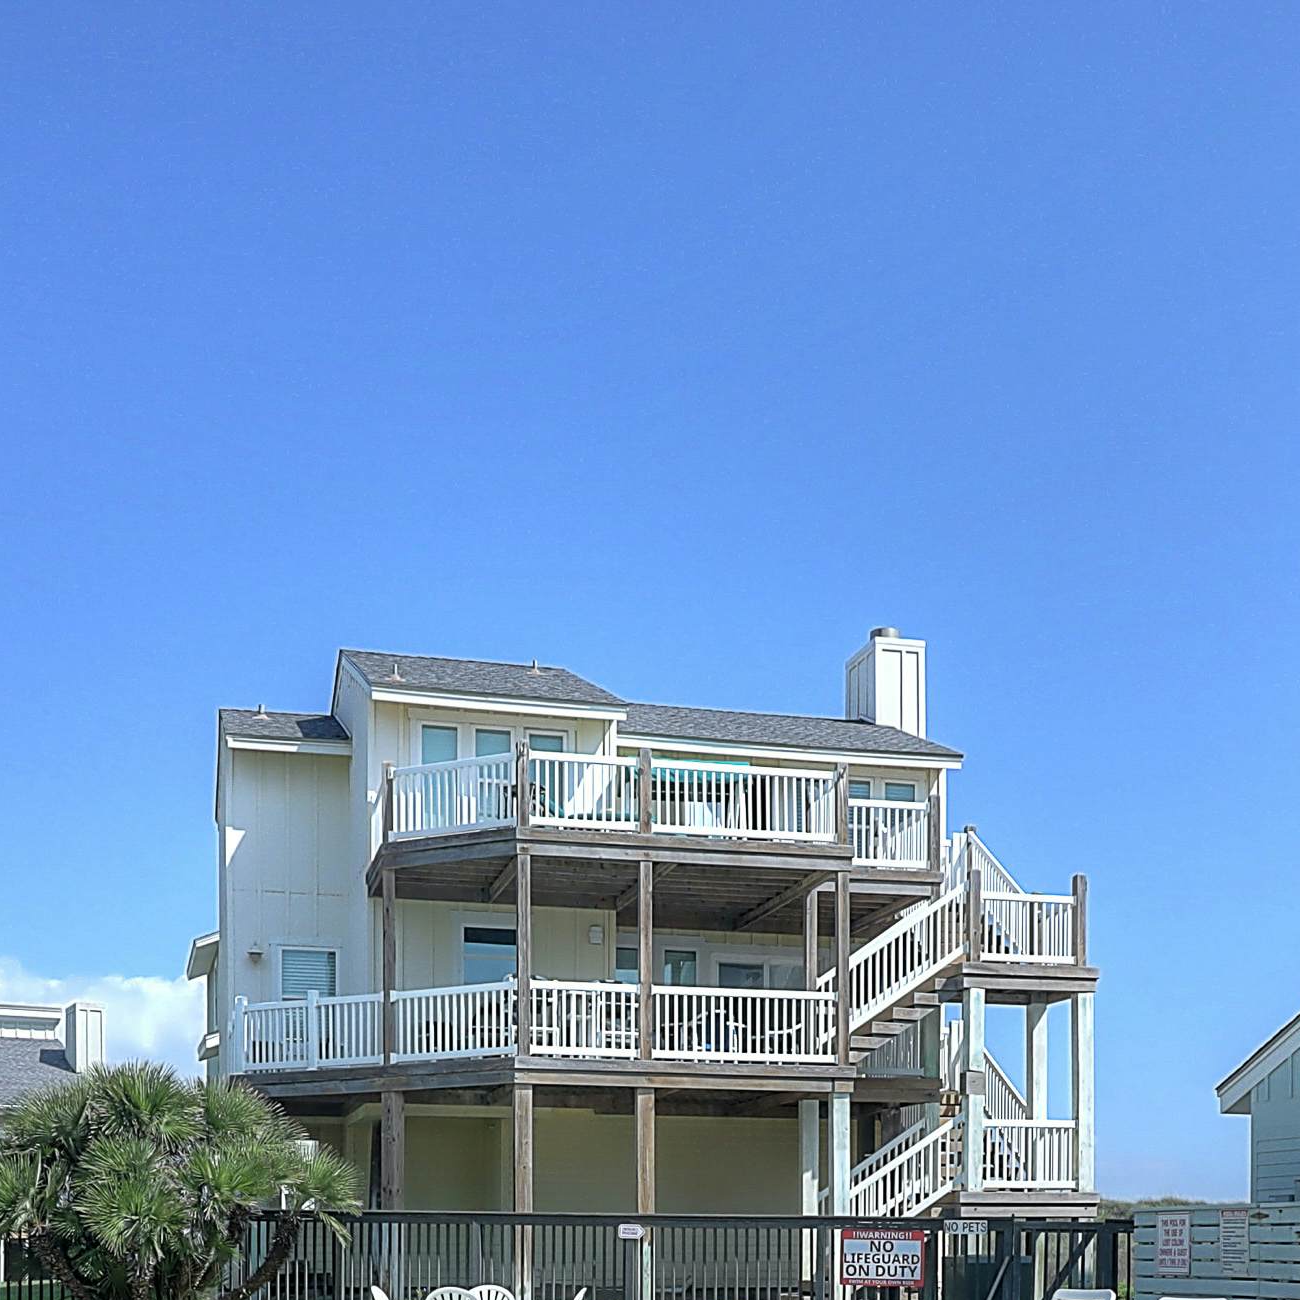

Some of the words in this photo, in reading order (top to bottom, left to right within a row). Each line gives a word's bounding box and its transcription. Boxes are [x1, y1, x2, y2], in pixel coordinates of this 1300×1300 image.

[945, 1222, 959, 1232] NO
[962, 1222, 987, 1233] PETS
[870, 1241, 894, 1253] NO
[844, 1253, 920, 1265] LIFEGUARD
[846, 1264, 870, 1276] ON
[875, 1265, 918, 1278] DUTY
